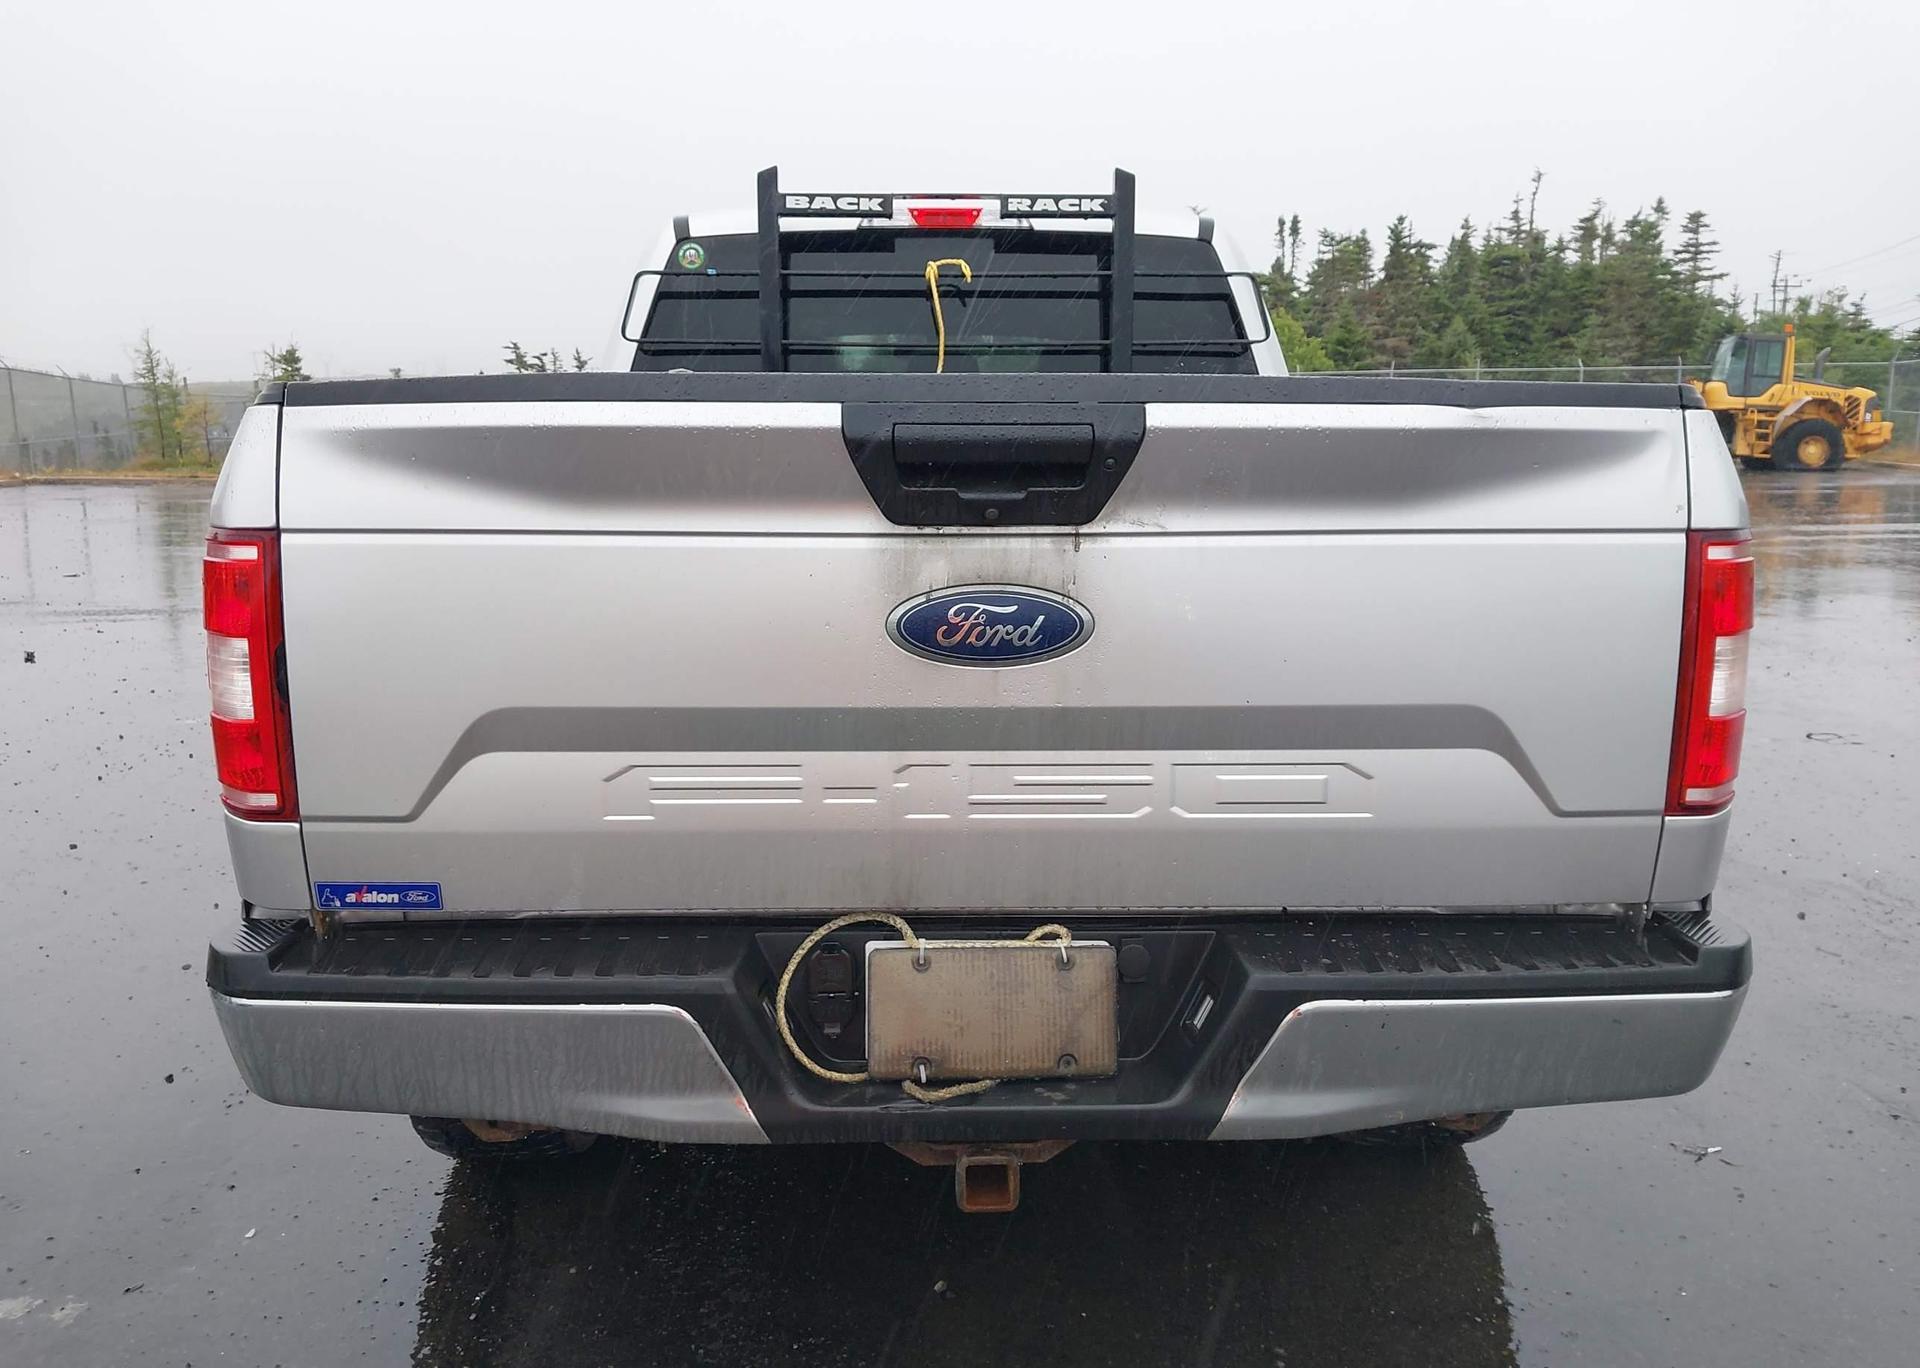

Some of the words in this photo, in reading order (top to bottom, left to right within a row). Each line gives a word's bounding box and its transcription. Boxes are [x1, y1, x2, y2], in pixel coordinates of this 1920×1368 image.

[786, 195, 884, 211] BACK
[1008, 197, 1106, 212] RACK
[936, 602, 1045, 647] Ford
[602, 763, 1374, 820] F-150
[345, 885, 399, 903] avalon
[406, 890, 429, 902] Ford
